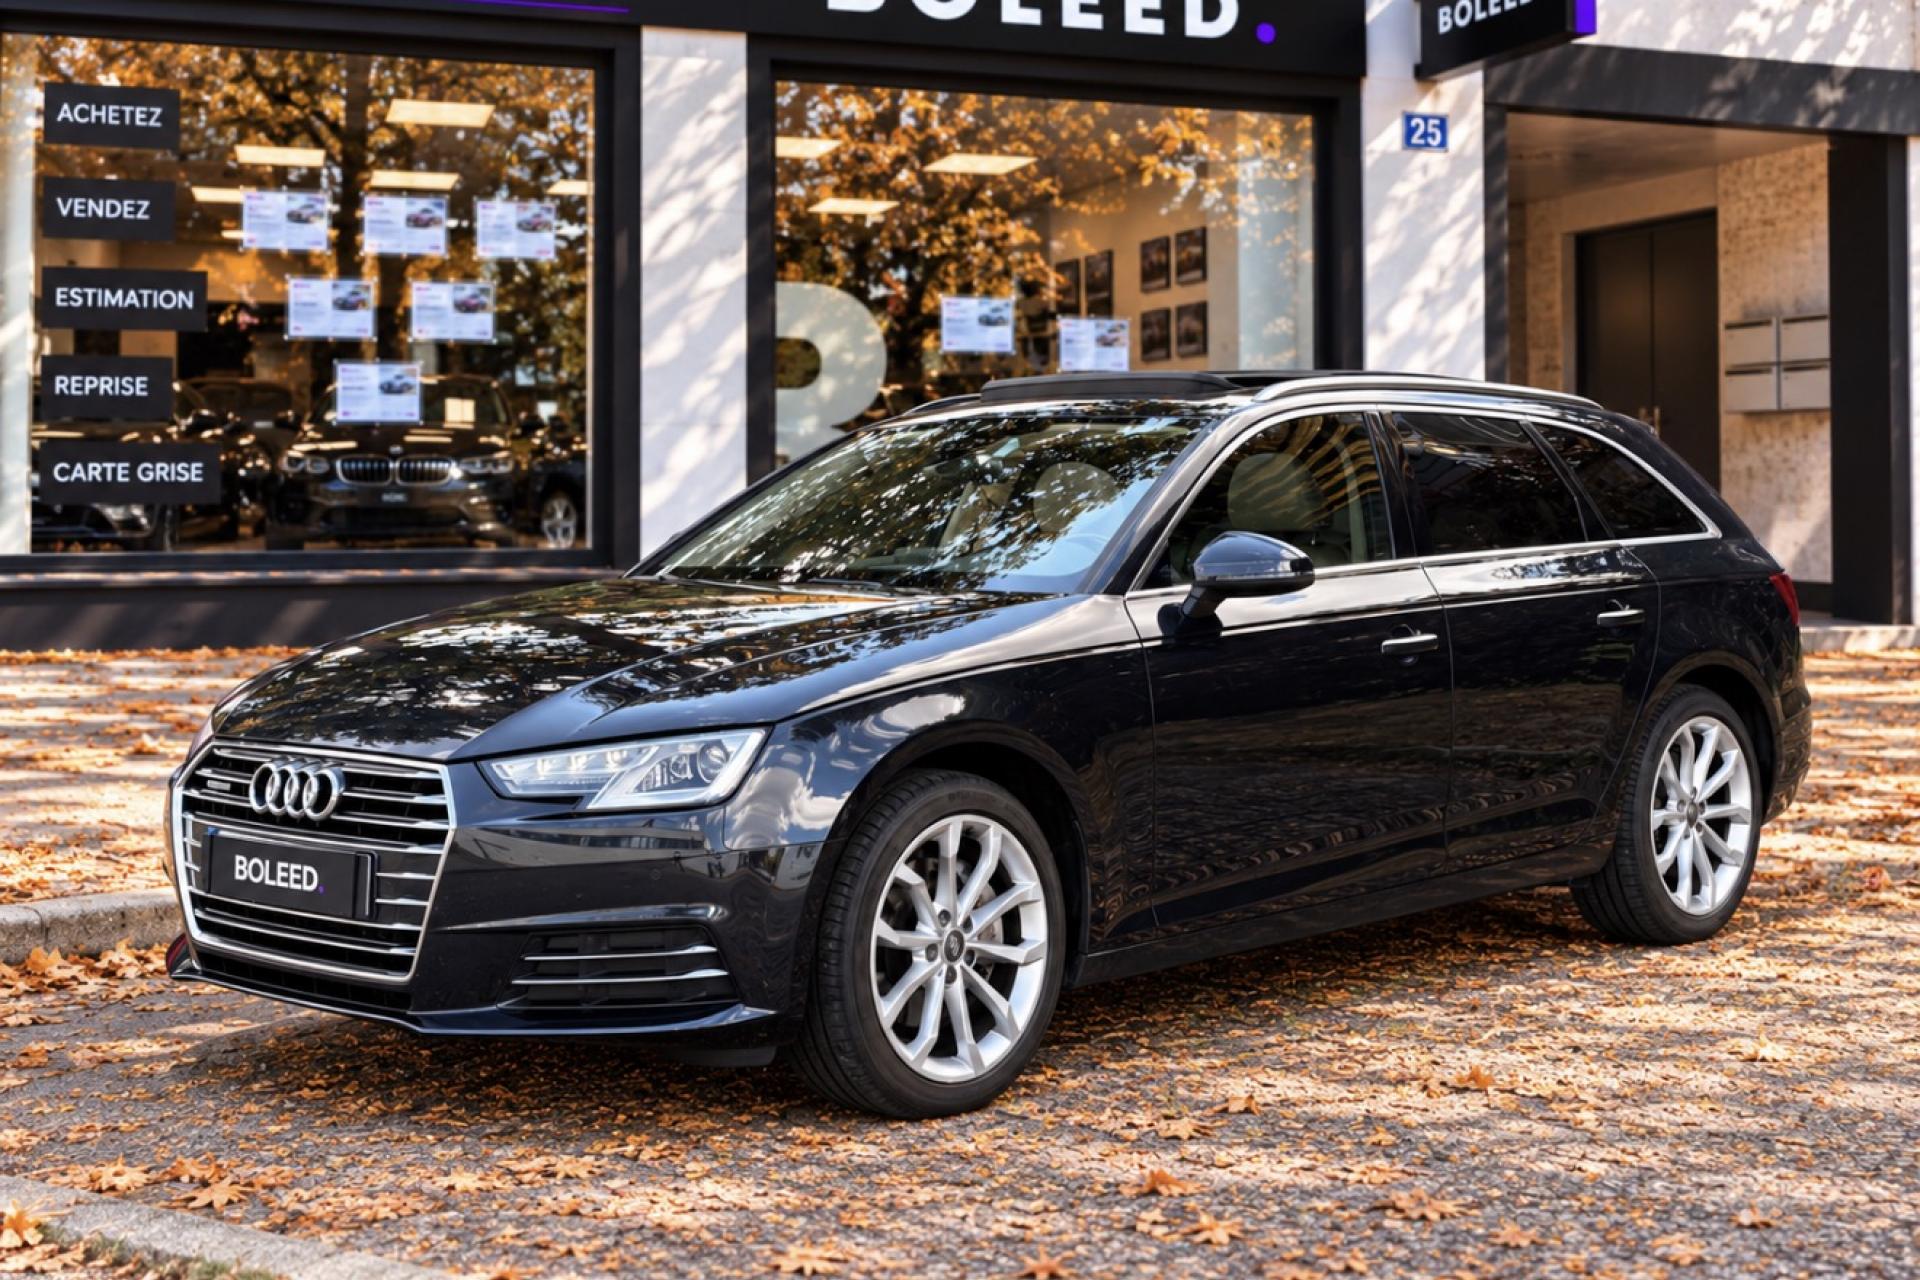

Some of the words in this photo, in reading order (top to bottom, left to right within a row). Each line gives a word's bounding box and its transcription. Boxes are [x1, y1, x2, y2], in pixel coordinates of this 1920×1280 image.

[827, 0, 1276, 44] EED.
[1438, 0, 1533, 35] BOLE
[57, 102, 162, 128] ACHETEZ
[1410, 117, 1442, 147] 25
[56, 197, 150, 220] VENDEZ
[55, 287, 194, 310] ESTIMATION
[54, 375, 149, 396] REPRISE
[53, 462, 130, 483] CARTE
[137, 462, 203, 483] GRISE
